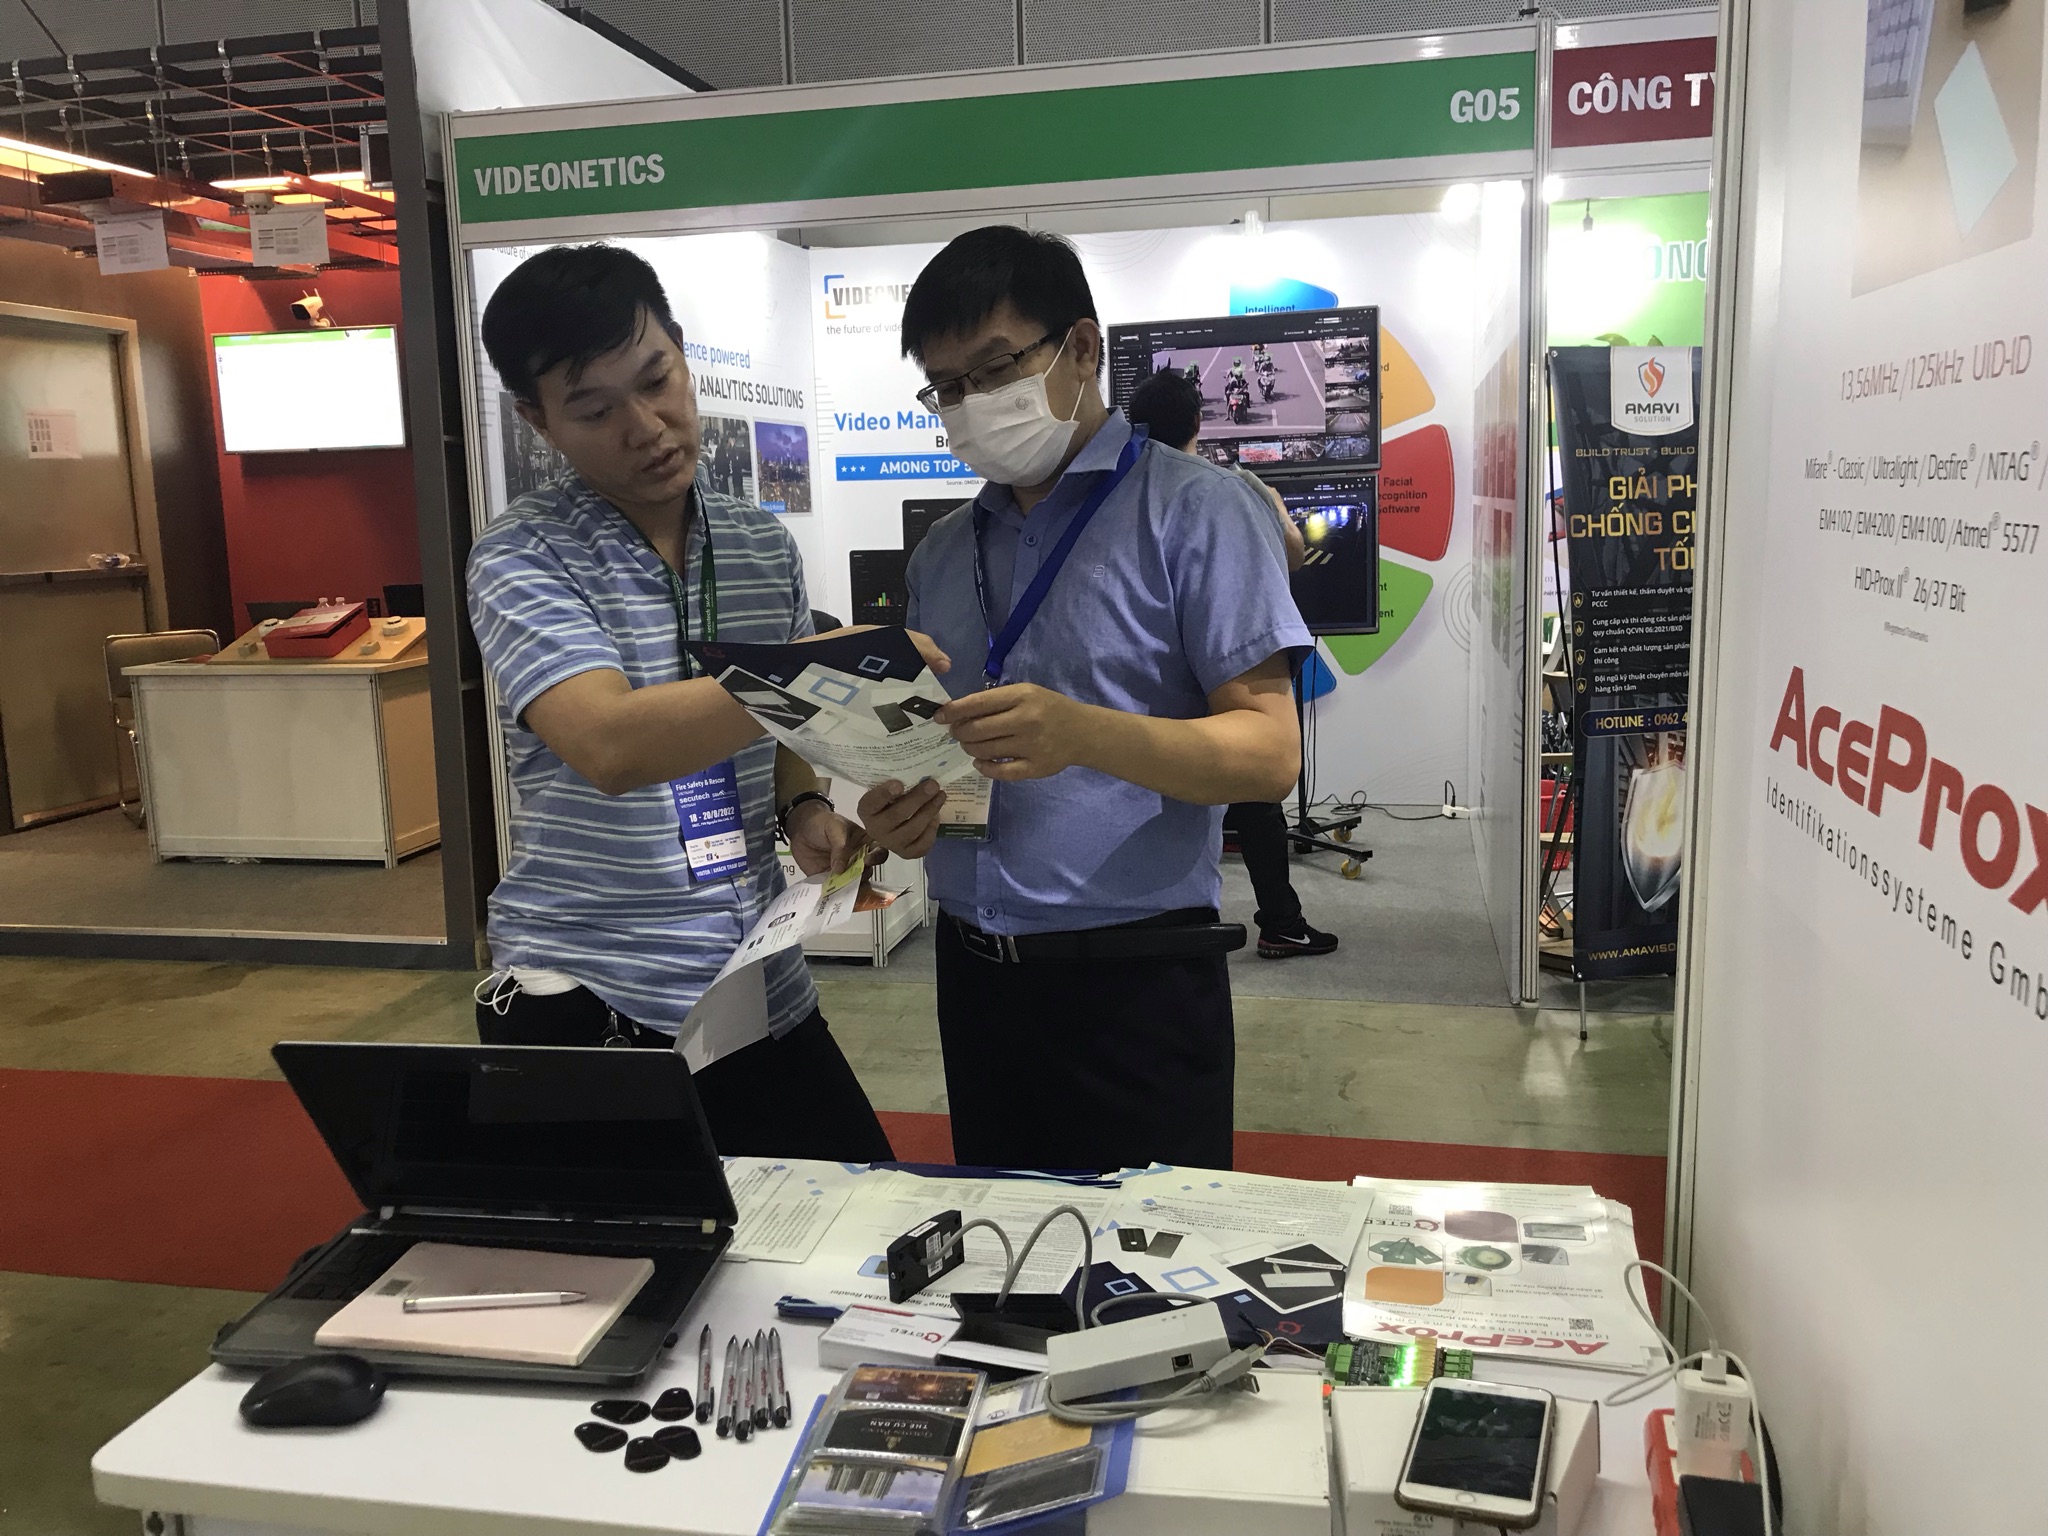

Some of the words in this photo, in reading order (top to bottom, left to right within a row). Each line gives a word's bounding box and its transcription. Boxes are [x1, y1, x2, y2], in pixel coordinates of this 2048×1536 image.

[1568, 72, 1672, 115] CÔNG
[474, 153, 666, 196] VIDEONETICS
[832, 284, 914, 306] VIDEONE
[827, 325, 842, 334] the
[843, 324, 871, 334] future
[873, 323, 882, 332] of
[710, 346, 751, 369] powered
[1972, 333, 2033, 381] UID-ID
[699, 374, 754, 402] ANALYTICS
[755, 383, 804, 409] SOLUTIONS
[1625, 403, 1680, 415] AMAVI
[834, 412, 891, 432] Video
[1575, 448, 1611, 457] BUILD
[1613, 447, 1651, 456] TRUST
[1660, 446, 1695, 455] BUILD
[879, 460, 930, 475] AMONG
[933, 459, 961, 473] TOP
[1837, 457, 1864, 480] Classic
[1872, 455, 1918, 487] Ultralight
[1383, 476, 1413, 487] Facial
[1609, 466, 1658, 500] GIẢI
[1570, 502, 1663, 538] CHỐNG
[2001, 522, 2040, 554] 5577
[1854, 566, 1894, 597] HID-Prox
[1912, 575, 1948, 611] 26/37
[1949, 583, 1967, 613] Bit
[1591, 600, 1608, 608] PCCC
[1630, 616, 1639, 624] thi
[1626, 627, 1644, 635] QCVN
[1595, 714, 1645, 730] HOTLINE
[1654, 712, 1679, 726] 0962
[675, 784, 687, 792] Fire
[687, 780, 704, 790] Safety
[709, 777, 726, 785] Rescue
[679, 791, 711, 804] secutech
[689, 813, 698, 823] 18
[1766, 776, 1973, 960] Identifikationssysteme
[1587, 942, 1677, 961] WWW.AMAVISO
[829, 1289, 863, 1299] Reader
[864, 1293, 887, 1301] OEM
